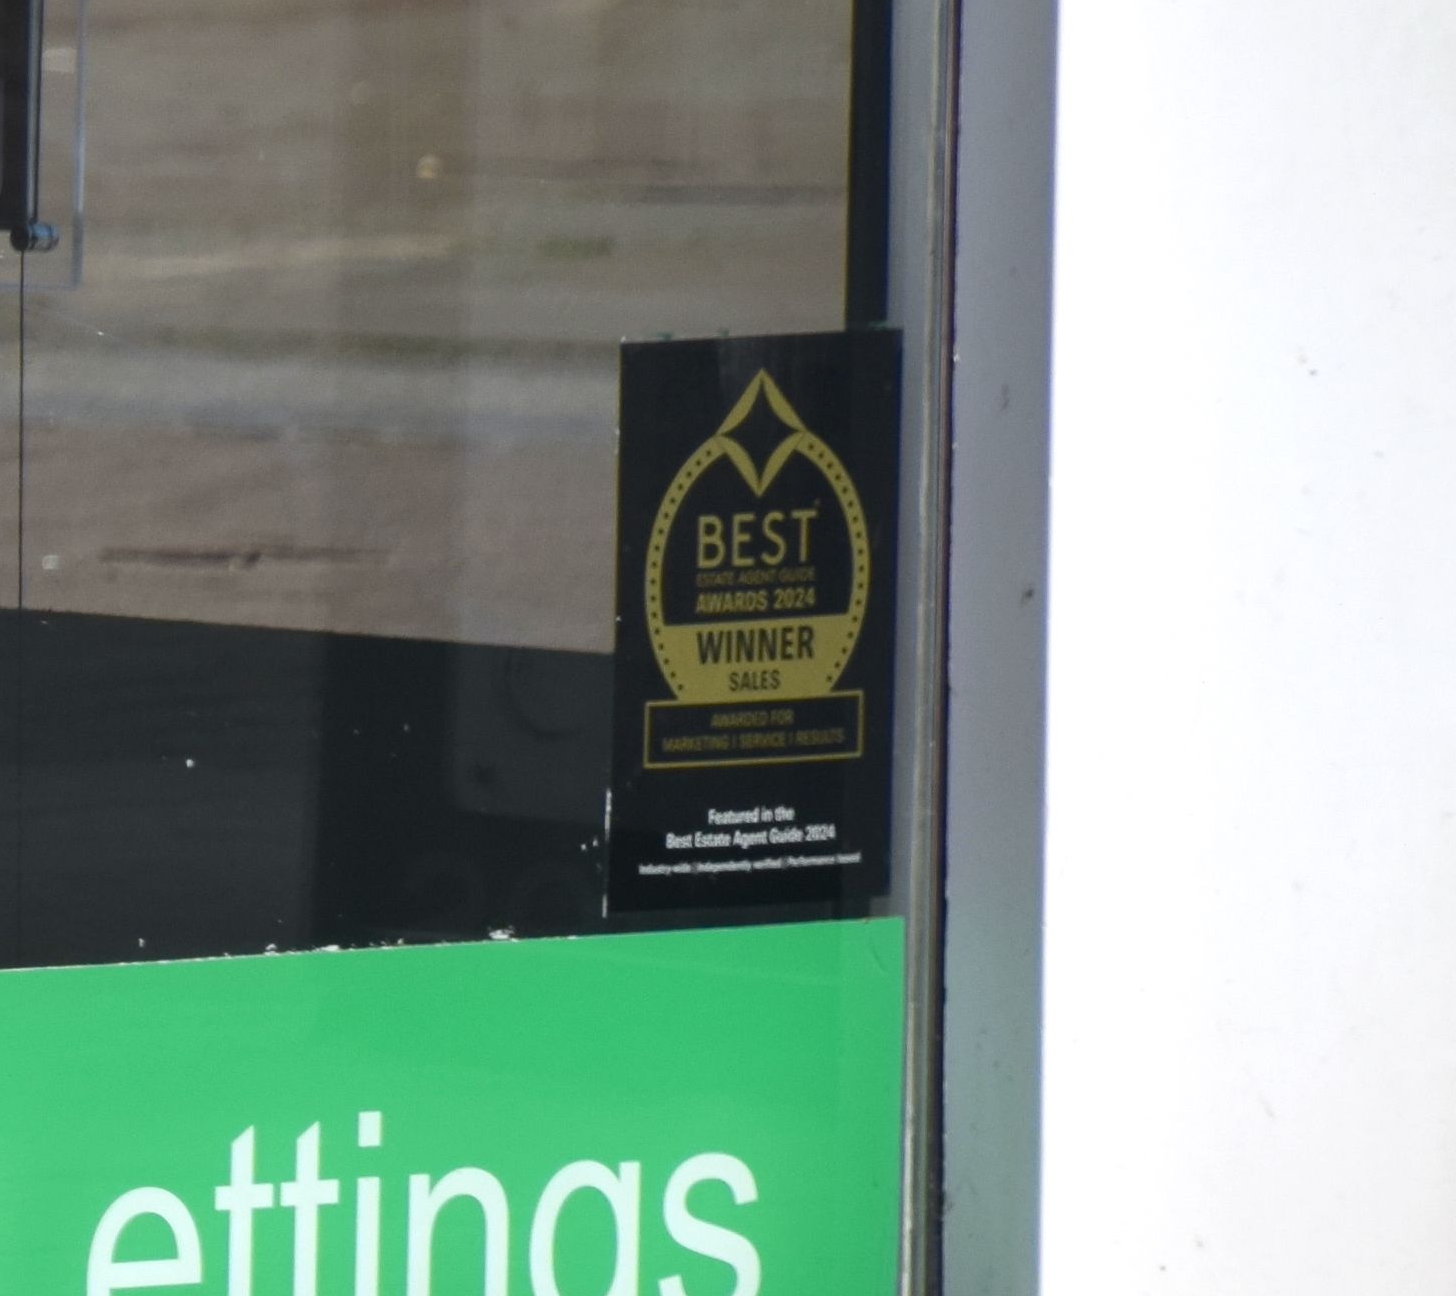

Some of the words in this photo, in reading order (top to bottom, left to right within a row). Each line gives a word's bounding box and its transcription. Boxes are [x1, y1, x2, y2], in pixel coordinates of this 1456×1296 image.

[697, 509, 818, 569] BEST
[695, 592, 767, 614] AWARDS
[774, 587, 816, 609] 2024
[696, 625, 814, 665] WINNER
[729, 669, 781, 692] SALES
[711, 711, 769, 728] AWARDED
[771, 709, 793, 724] FOR
[739, 732, 785, 748] SERVICE
[708, 808, 759, 825] Featured
[761, 807, 773, 822] in
[775, 805, 795, 821] the
[666, 833, 693, 849] Best
[695, 832, 731, 848] Estate
[733, 830, 768, 849] Agent
[770, 827, 803, 844] Guide
[805, 823, 835, 841] 2024
